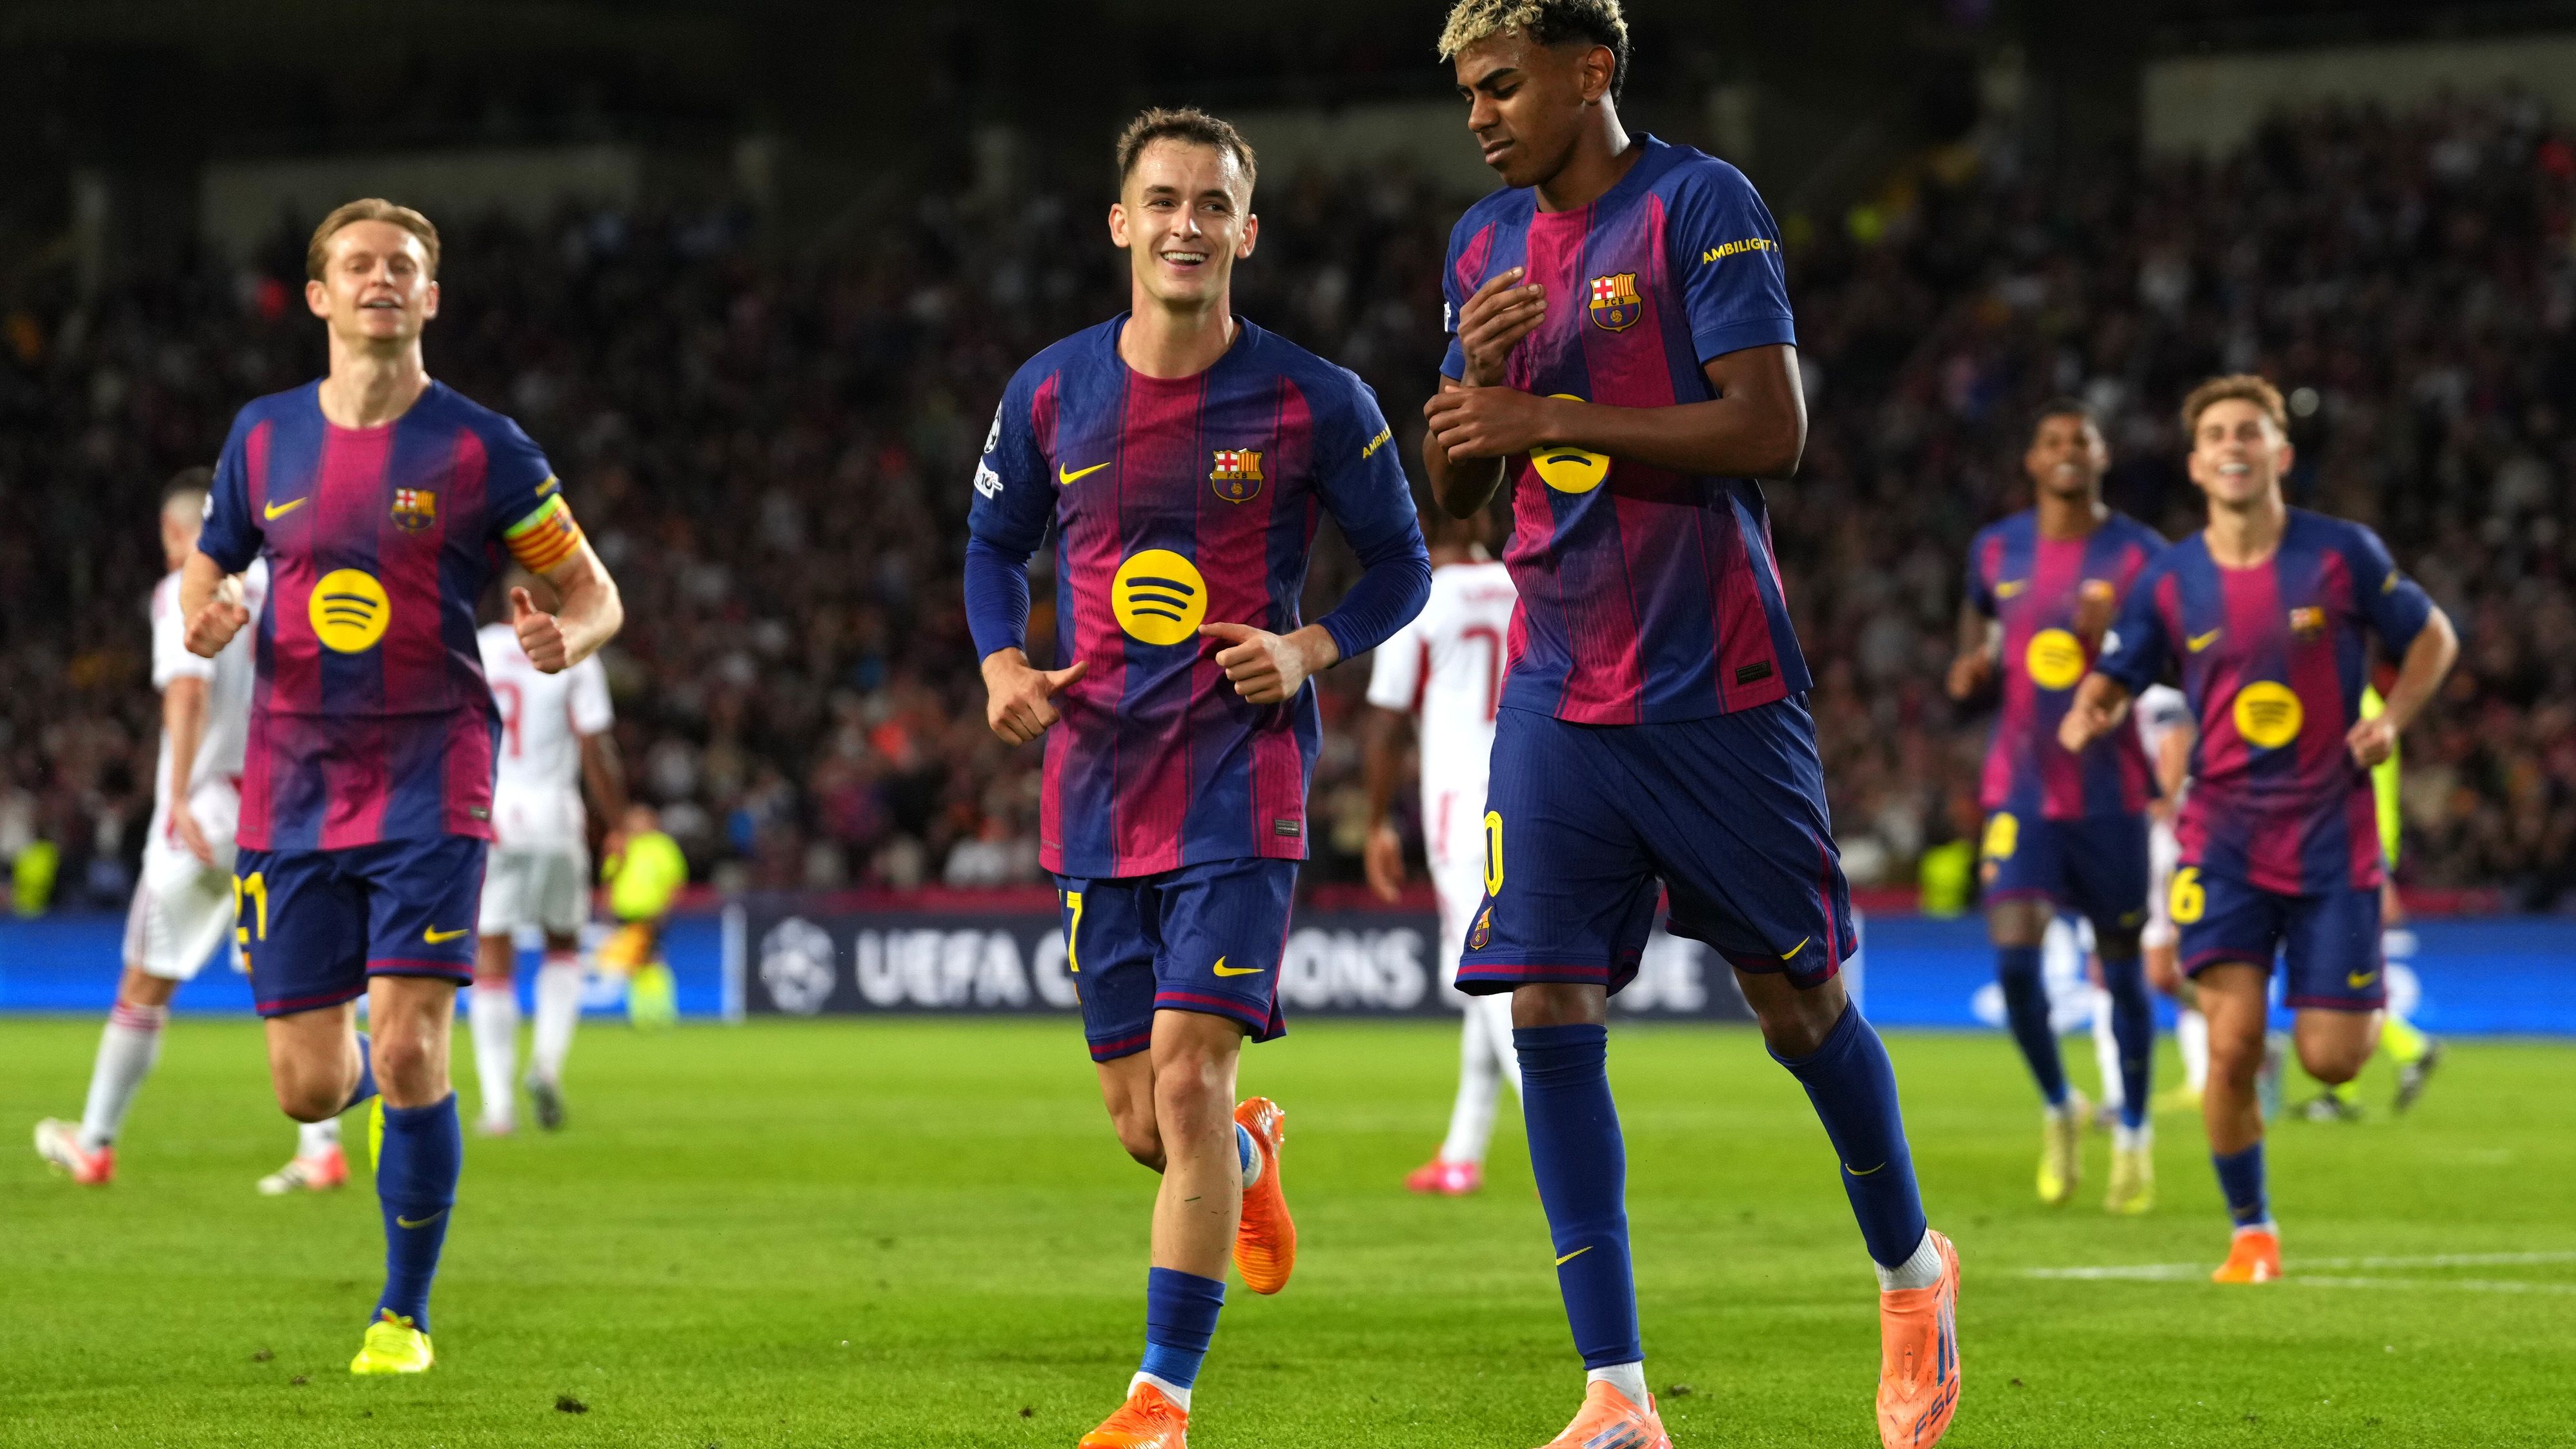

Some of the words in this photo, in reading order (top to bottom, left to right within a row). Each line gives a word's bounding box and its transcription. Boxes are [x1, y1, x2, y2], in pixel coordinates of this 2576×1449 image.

[1605, 297, 1625, 307] FCB
[855, 927, 1029, 1008] UEFA
[1058, 889, 1083, 972] 7
[1914, 1374, 1958, 1446] F50
